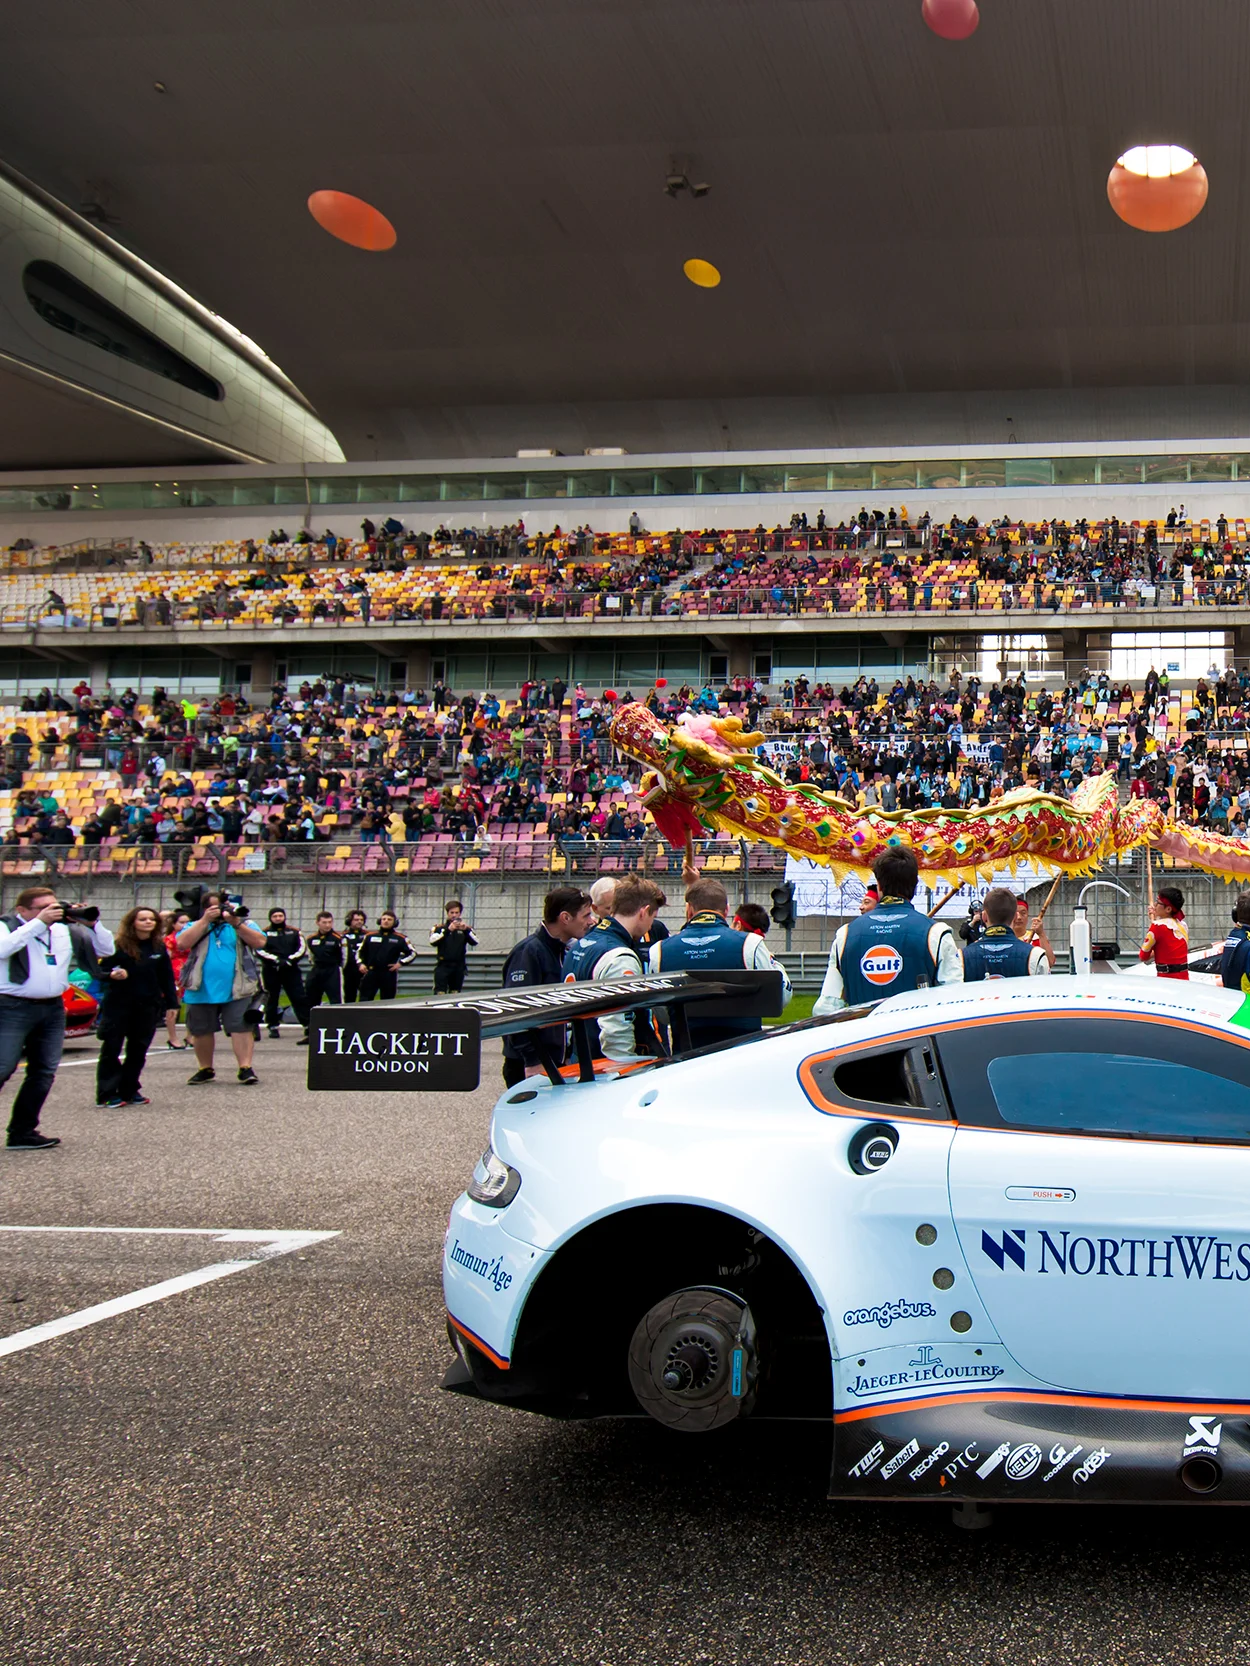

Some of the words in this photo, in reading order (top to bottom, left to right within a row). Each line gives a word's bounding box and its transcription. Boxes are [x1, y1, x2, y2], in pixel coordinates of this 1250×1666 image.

[511, 974, 525, 982] GB
[862, 960, 901, 972] Gulf
[317, 1028, 469, 1057] HACKETT
[354, 1060, 430, 1073] LONDON
[884, 1444, 916, 1475] Sabelt
[909, 1441, 950, 1480] RECARO
[1008, 1443, 1042, 1477] HELLA
